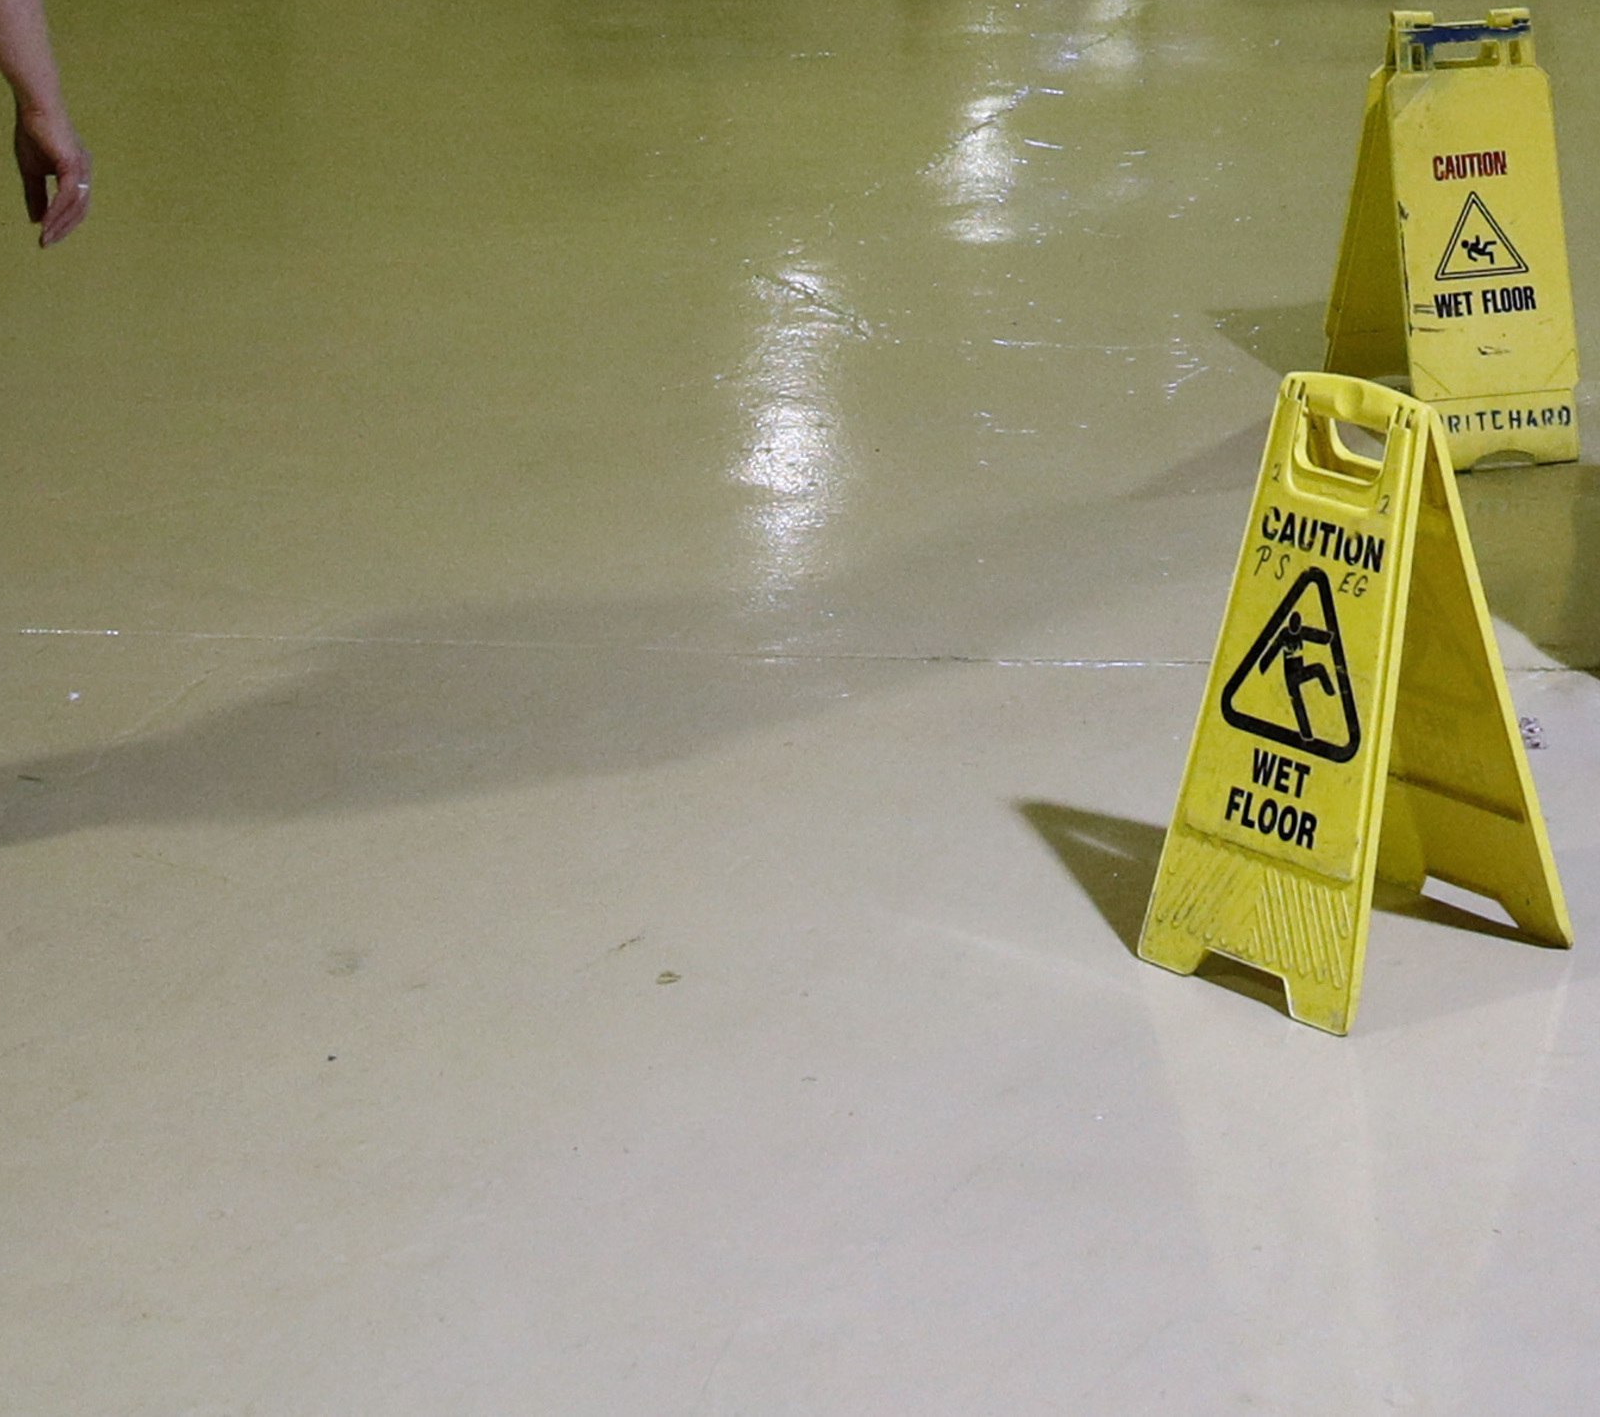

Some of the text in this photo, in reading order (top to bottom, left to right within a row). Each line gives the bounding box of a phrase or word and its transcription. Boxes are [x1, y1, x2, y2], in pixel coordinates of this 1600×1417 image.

[1432, 151, 1508, 182] CAUTION
[1434, 285, 1537, 319] WET FLOOR
[1441, 405, 1571, 434] RITCHARD
[1261, 506, 1385, 574] CAUTION
[1252, 748, 1312, 799] WET
[1224, 786, 1318, 850] FLOOR
